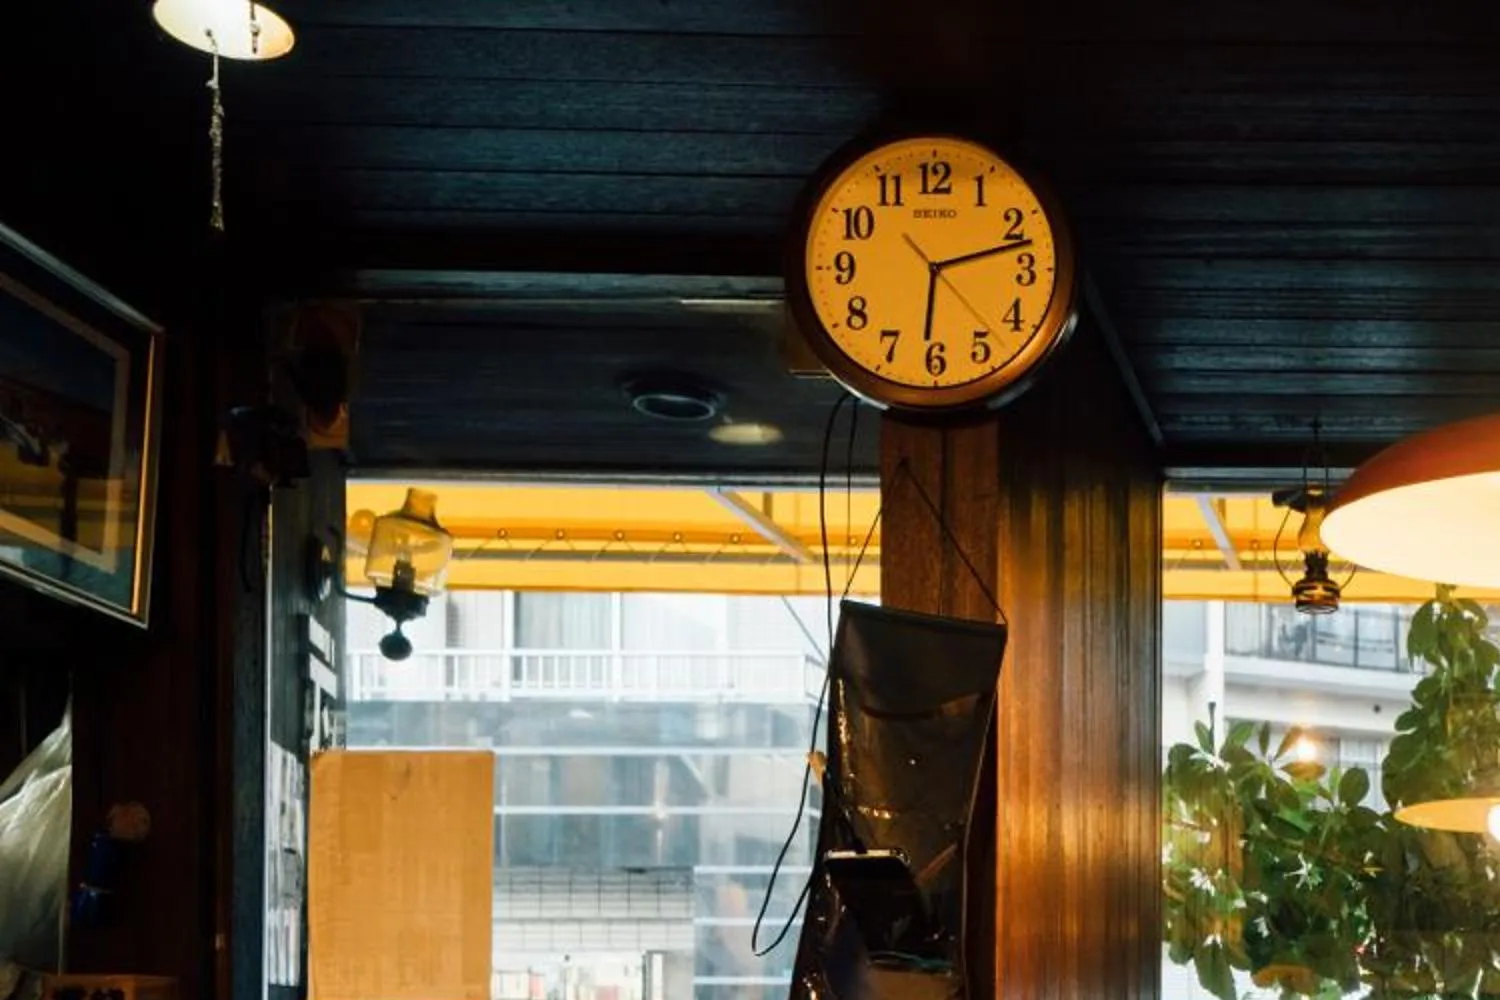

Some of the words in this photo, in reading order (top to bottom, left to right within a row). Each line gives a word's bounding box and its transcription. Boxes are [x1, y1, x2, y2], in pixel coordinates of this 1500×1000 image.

[877, 174, 904, 206] 11
[918, 161, 951, 195] 12
[974, 175, 987, 207] 1
[842, 206, 874, 240] 10
[913, 209, 957, 218] SEIKO
[1003, 208, 1024, 240] 2
[834, 252, 856, 285] 9
[1015, 253, 1037, 286] 3
[846, 296, 868, 329] 8
[1002, 297, 1026, 332] 4
[879, 330, 900, 364] 7
[925, 343, 946, 376] 6
[971, 331, 991, 364] 5
